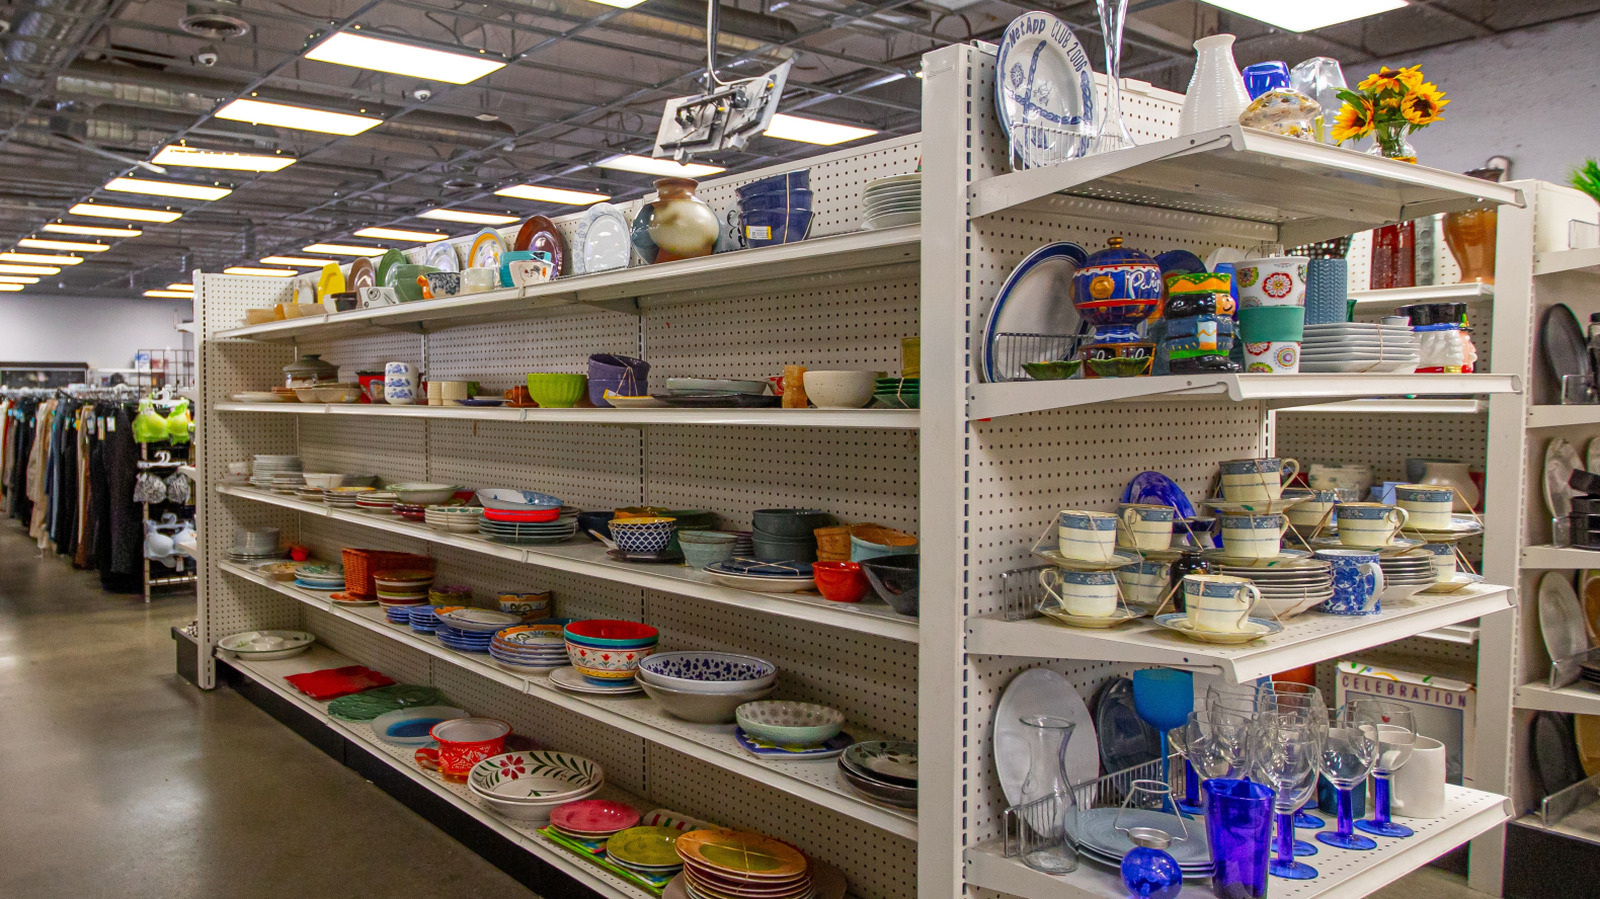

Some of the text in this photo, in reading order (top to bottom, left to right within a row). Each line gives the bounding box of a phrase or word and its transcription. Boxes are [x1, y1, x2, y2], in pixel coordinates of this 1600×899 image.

[1009, 16, 1088, 72] NetApp CLUB 2006
[1342, 675, 1467, 707] CELEBRATION
